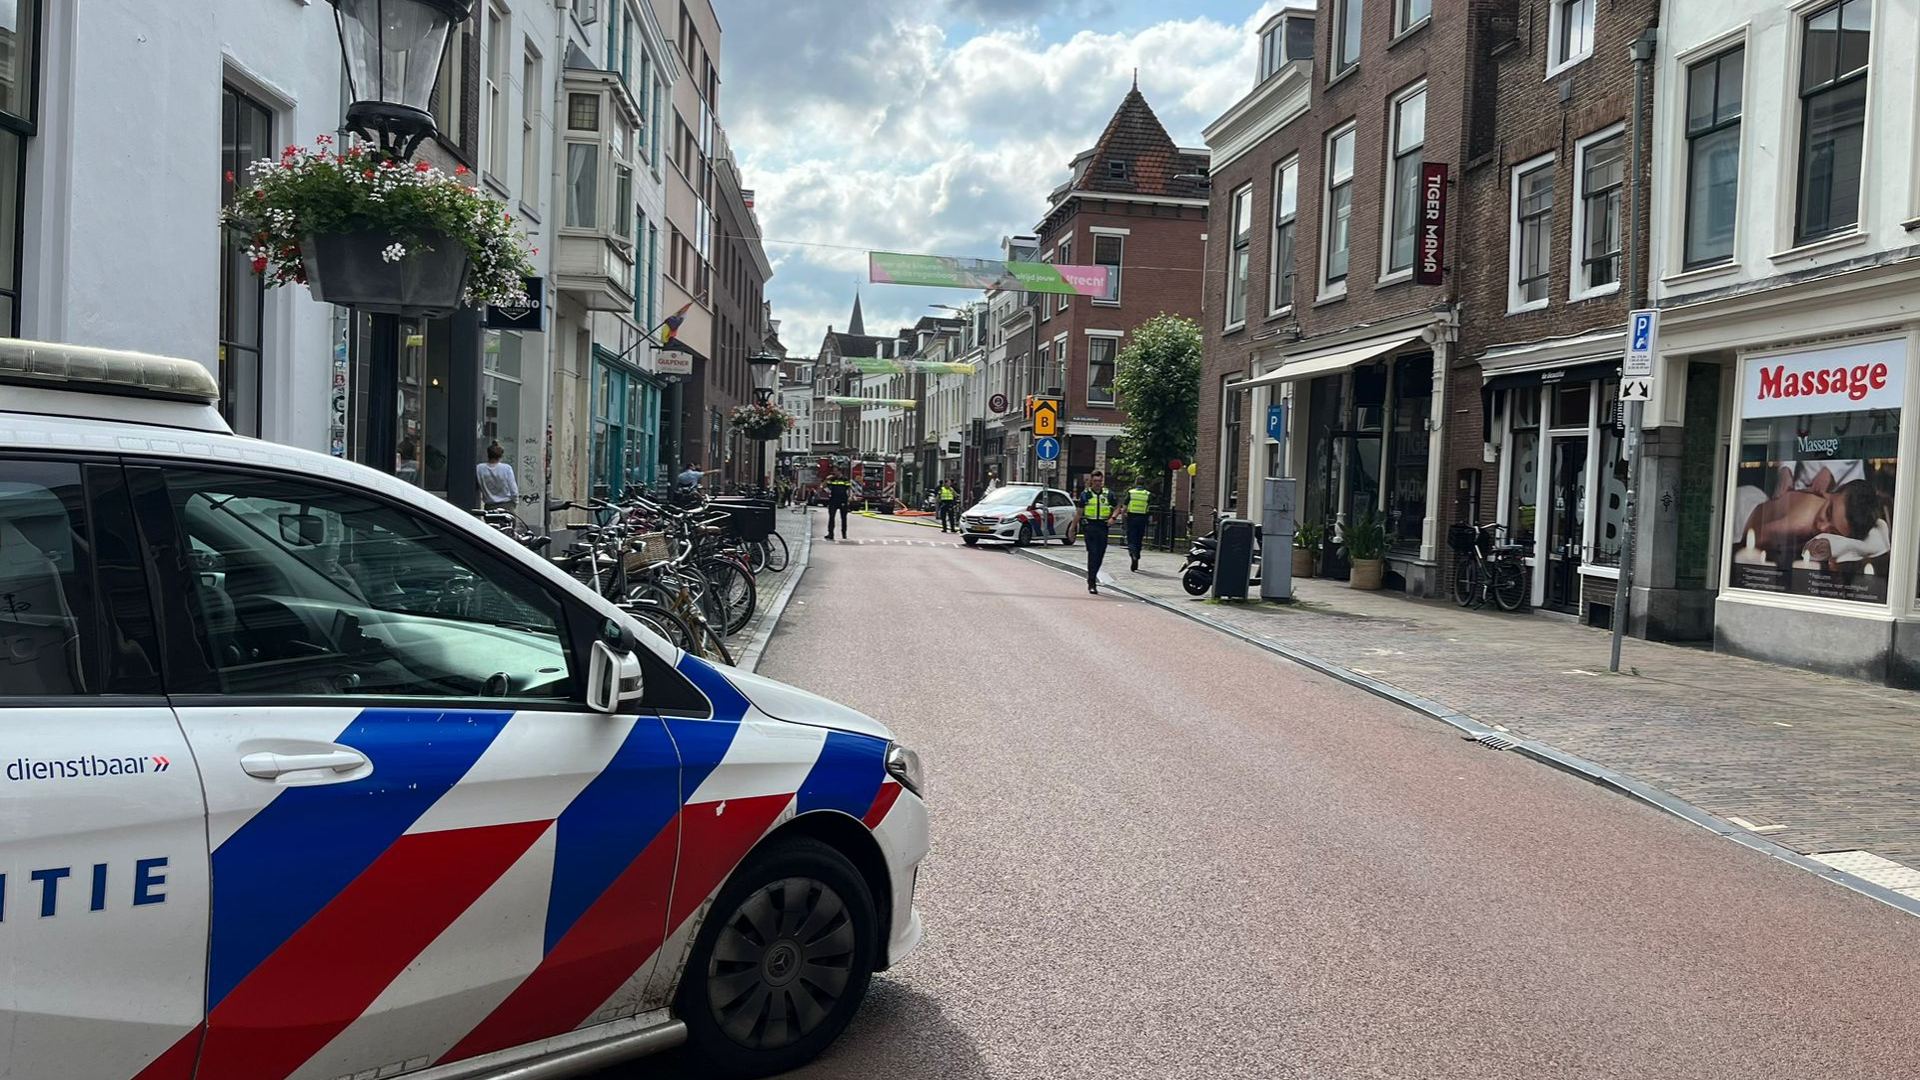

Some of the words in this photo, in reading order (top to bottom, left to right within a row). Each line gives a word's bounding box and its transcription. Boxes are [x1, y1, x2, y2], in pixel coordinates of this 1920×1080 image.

[1426, 174, 1441, 220] TIGER
[1423, 225, 1439, 273] MAMA
[1036, 274, 1055, 283] jouw
[1066, 273, 1104, 287] trecht
[1757, 363, 1888, 401] Massage
[1041, 416, 1049, 427] B
[1798, 437, 1839, 456] Massage
[6, 755, 149, 781] dienstbaar
